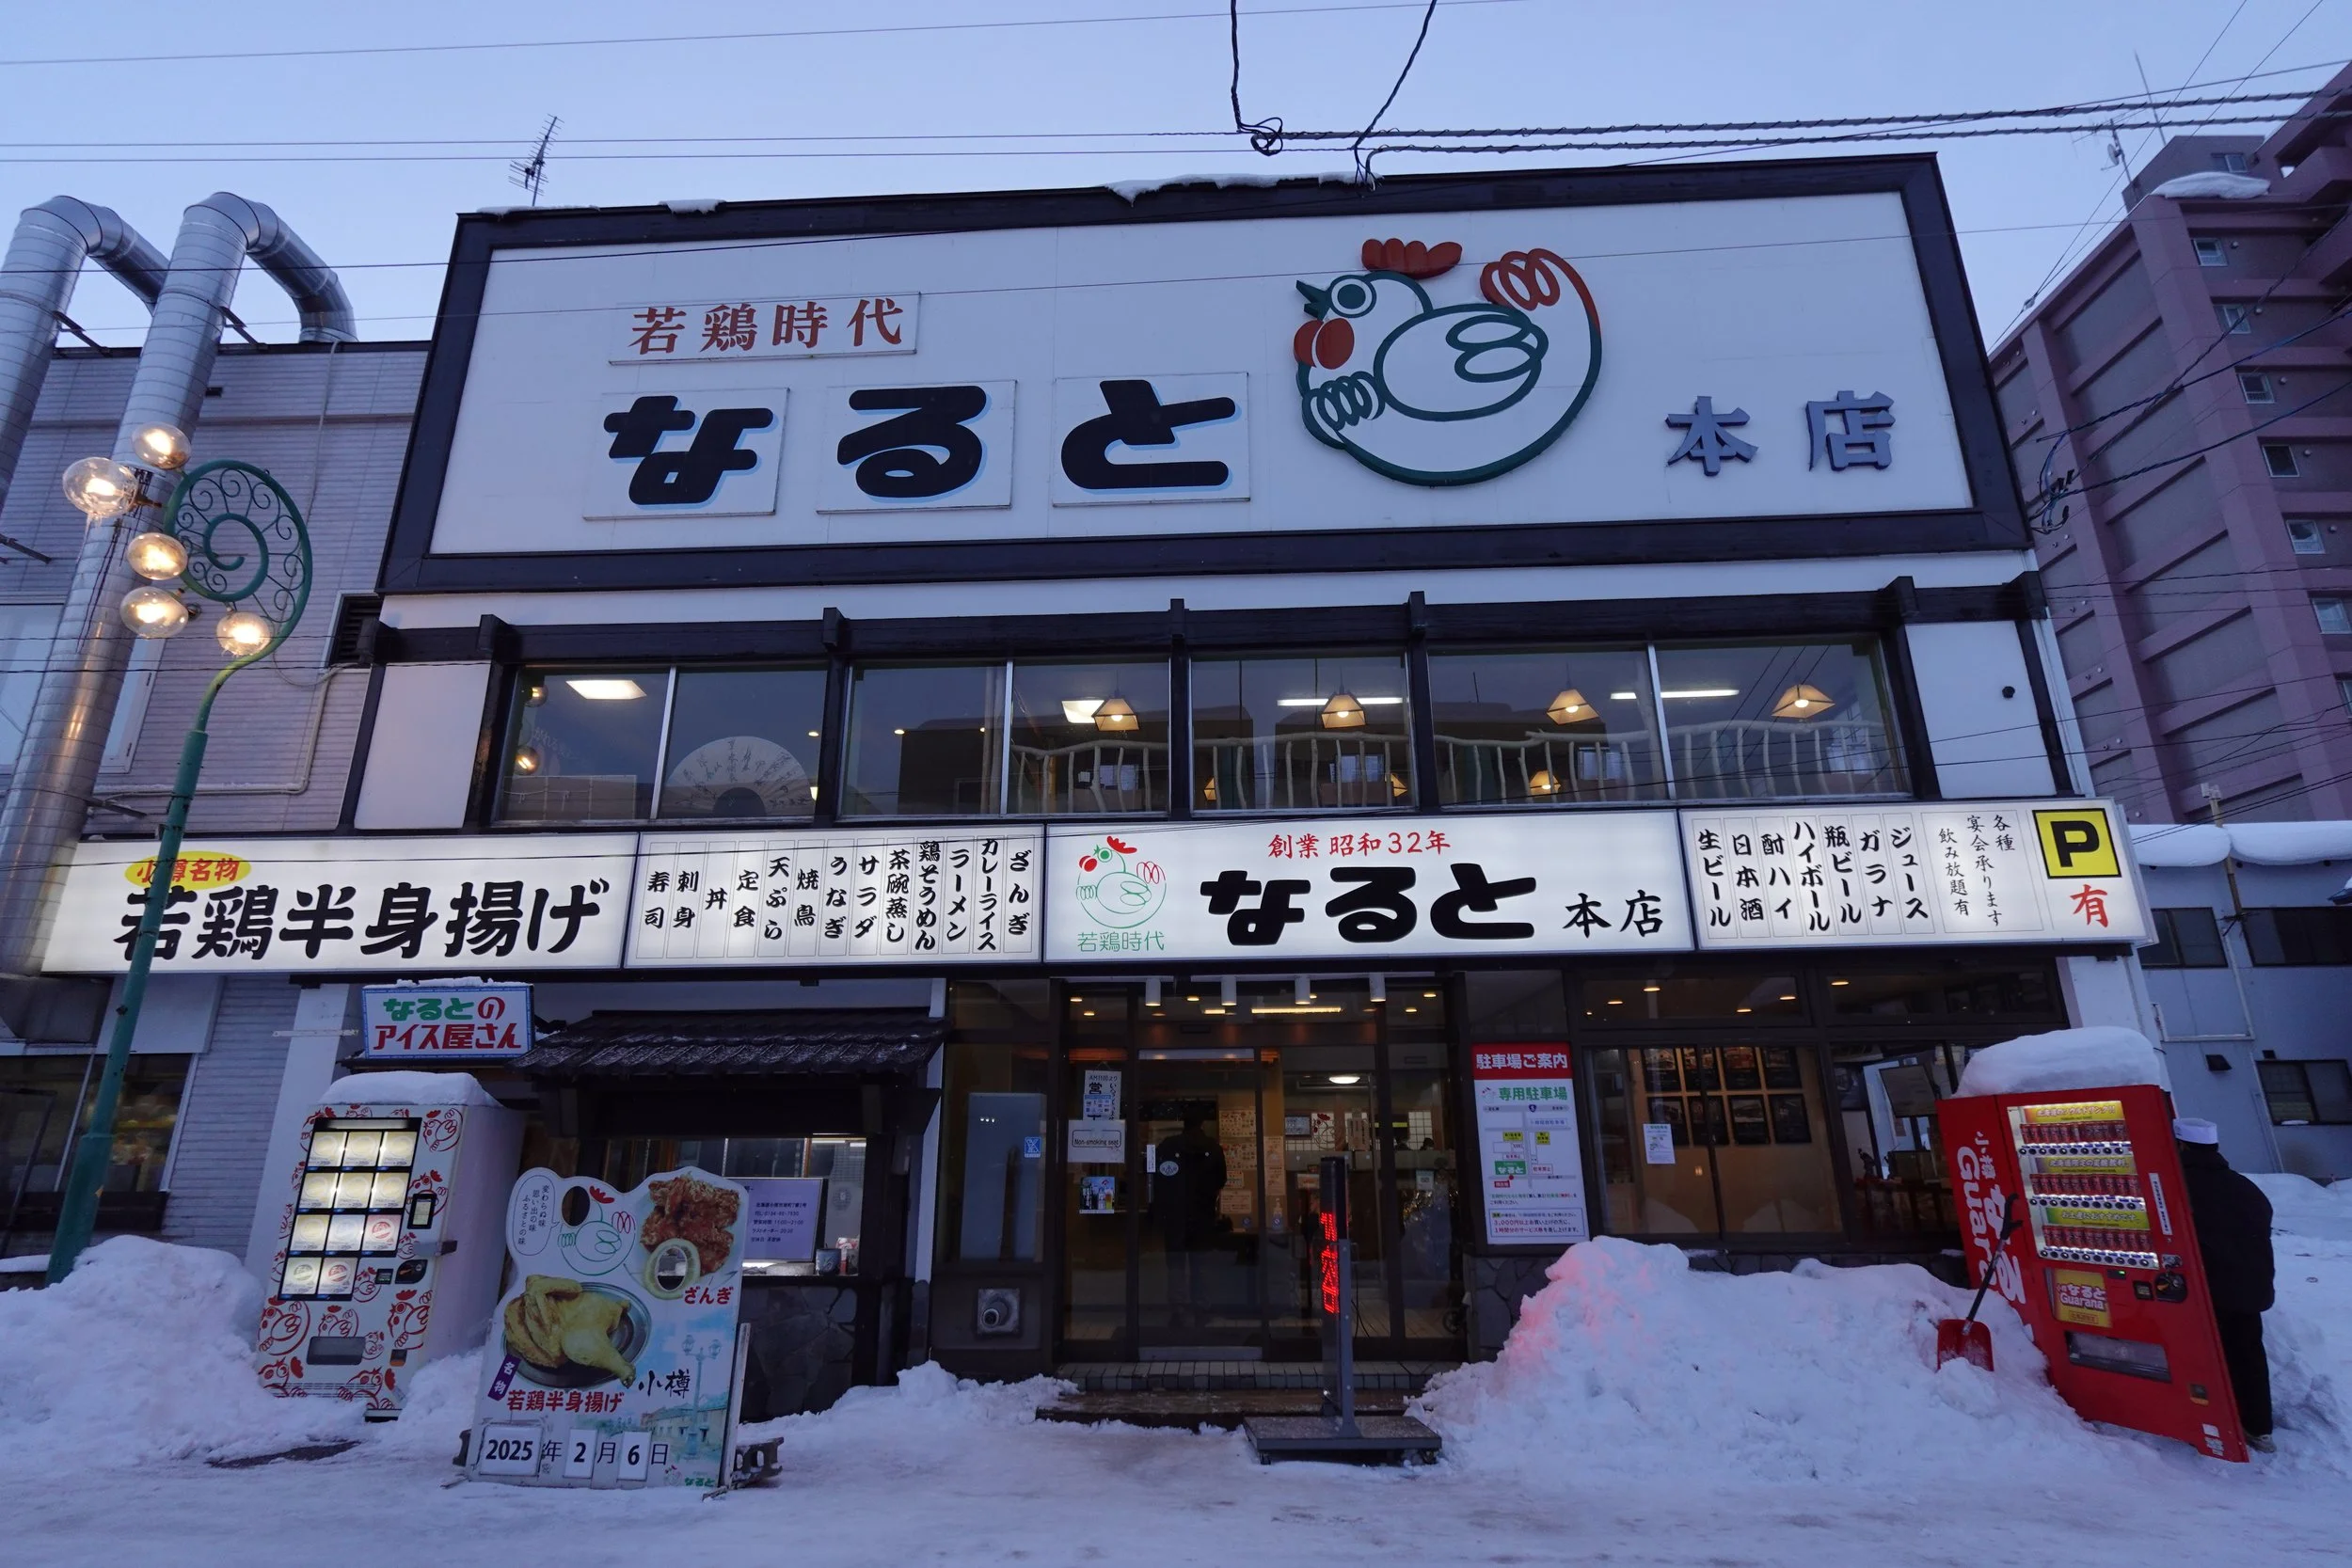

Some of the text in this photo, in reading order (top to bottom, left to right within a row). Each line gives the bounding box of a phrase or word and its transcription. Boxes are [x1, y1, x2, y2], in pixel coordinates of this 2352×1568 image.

[630, 297, 903, 354] 若鶏時代
[603, 379, 1896, 506] なると 本店
[1267, 830, 1451, 859] 創業 昭和32年
[1994, 814, 2015, 851] 各種
[2052, 820, 2100, 867] P
[644, 870, 670, 928] 寿司
[673, 870, 699, 929] 刺身
[705, 887, 728, 911] 丼
[733, 869, 759, 928] 定食
[764, 856, 790, 941] 天ぷら
[793, 868, 819, 927] 焼鳥
[824, 855, 849, 940] うなぎ
[854, 855, 881, 939] サラダ
[885, 847, 911, 942] 茶碗蒸し
[914, 840, 941, 951] 鶏そうめん
[946, 847, 971, 942] ラーメン
[977, 837, 999, 952] カレーライス
[1008, 849, 1032, 935] ざんぎ
[1697, 828, 1731, 928] 生ビール
[1731, 833, 1764, 922] 日本酒
[1759, 832, 1792, 921] 酎ハイ
[1793, 821, 1831, 932] ハイボール
[1823, 825, 1862, 925] 瓶ビール
[1860, 830, 1893, 918] ガラナ
[1890, 826, 1929, 920] ジュース
[1938, 828, 1969, 916] 飲み放題有
[1966, 815, 2002, 927] 宴会承ります
[113, 879, 609, 961] 若鶏半身揚げ
[1200, 863, 1663, 946] なると 本店
[2070, 884, 2110, 928] 有
[1077, 930, 1165, 952] 若鶏時代
[373, 1022, 521, 1051] アイス屋さん
[383, 996, 505, 1022] なるとの
[1476, 1053, 1568, 1069] 駐車場ご案内
[1499, 1086, 1568, 1101] 専用駐車場
[684, 1286, 734, 1305] ざんぎ
[2059, 1292, 2106, 1310] Guarana
[2067, 1284, 2106, 1301] なると
[494, 1361, 516, 1395] 名物
[506, 1390, 625, 1413] 若鶏半身揚げ
[639, 1369, 691, 1399] 小樽
